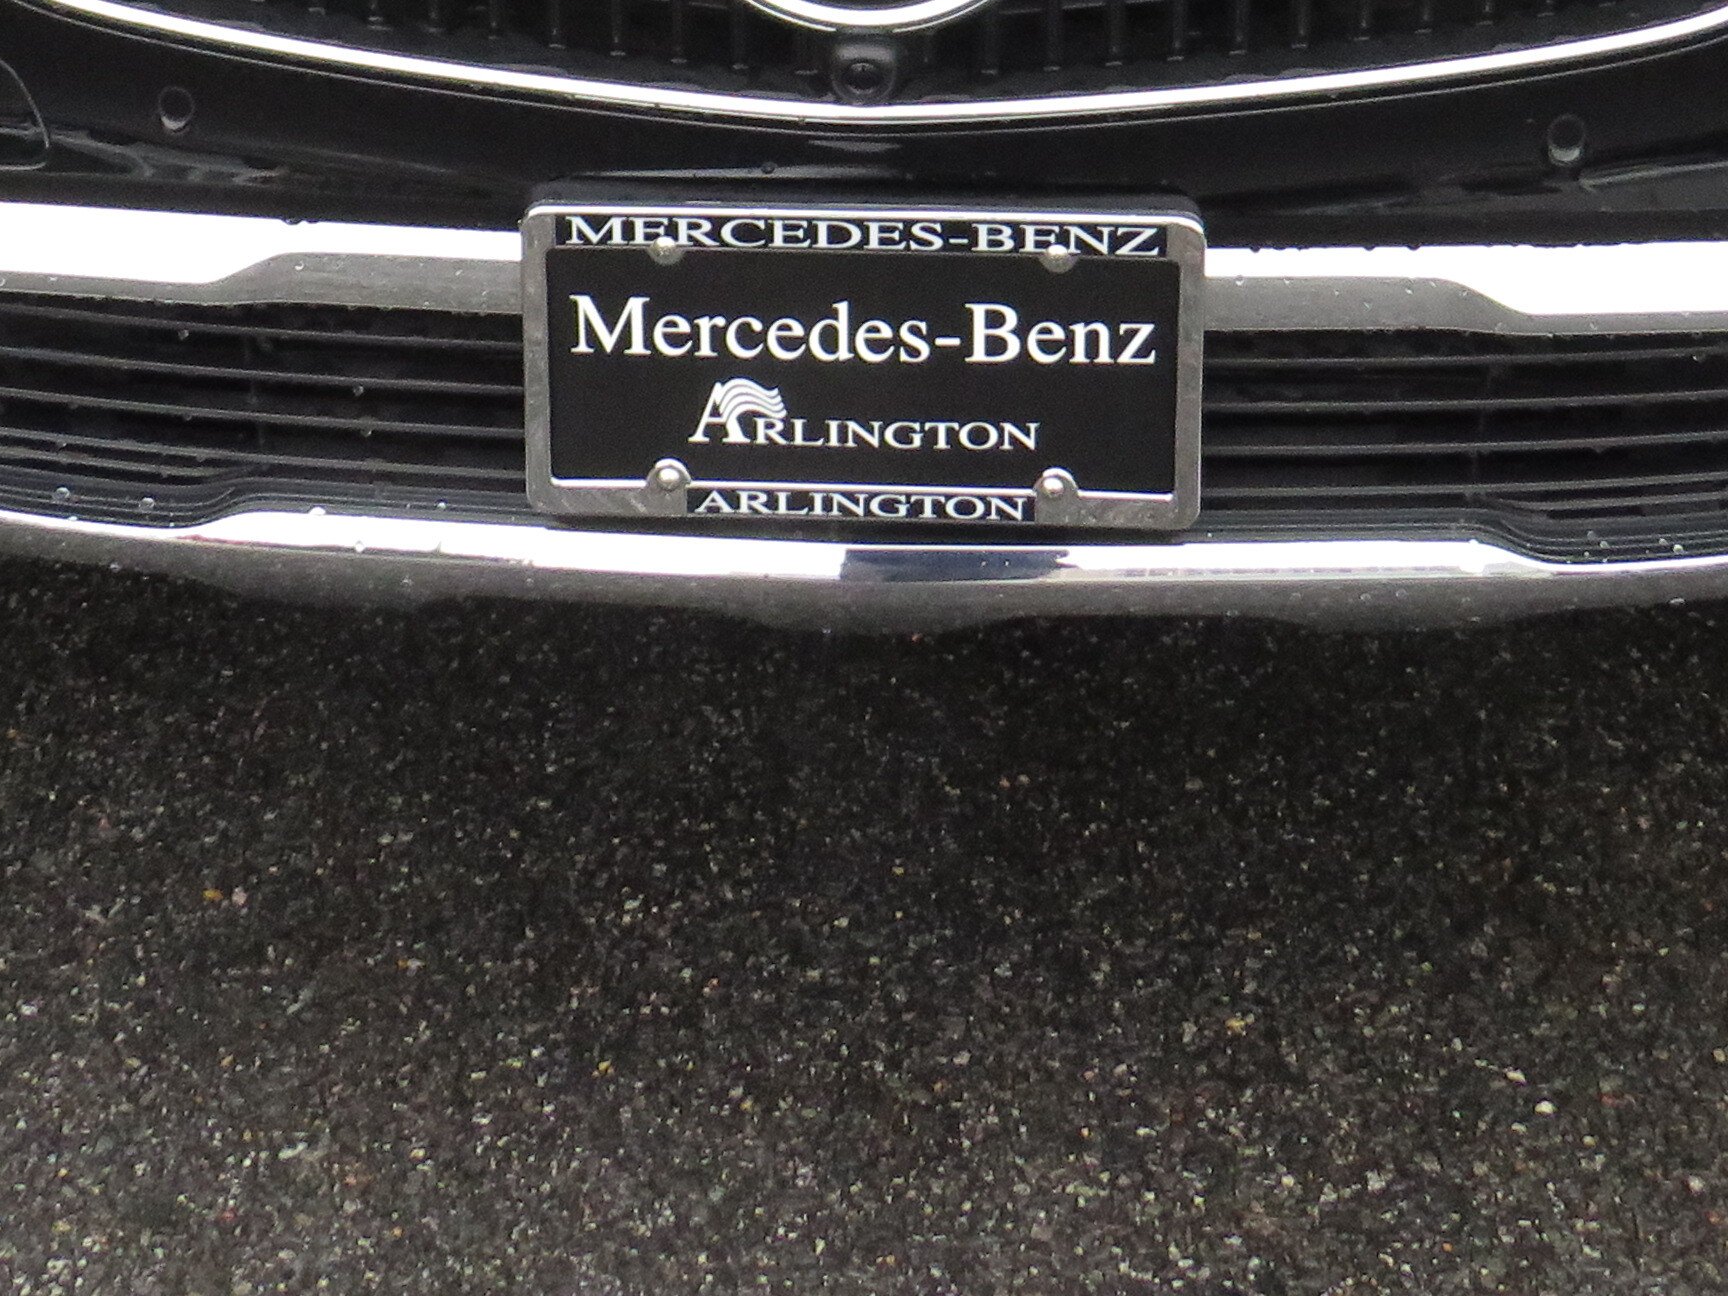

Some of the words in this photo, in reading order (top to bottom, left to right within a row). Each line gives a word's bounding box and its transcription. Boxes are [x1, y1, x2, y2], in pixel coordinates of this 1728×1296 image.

[565, 215, 1159, 256] MERCEDES-BENZ
[570, 294, 1156, 364] Mercedes-Benz
[688, 378, 1040, 450] ARLINGTON
[694, 489, 1027, 521] ARLINGTON
